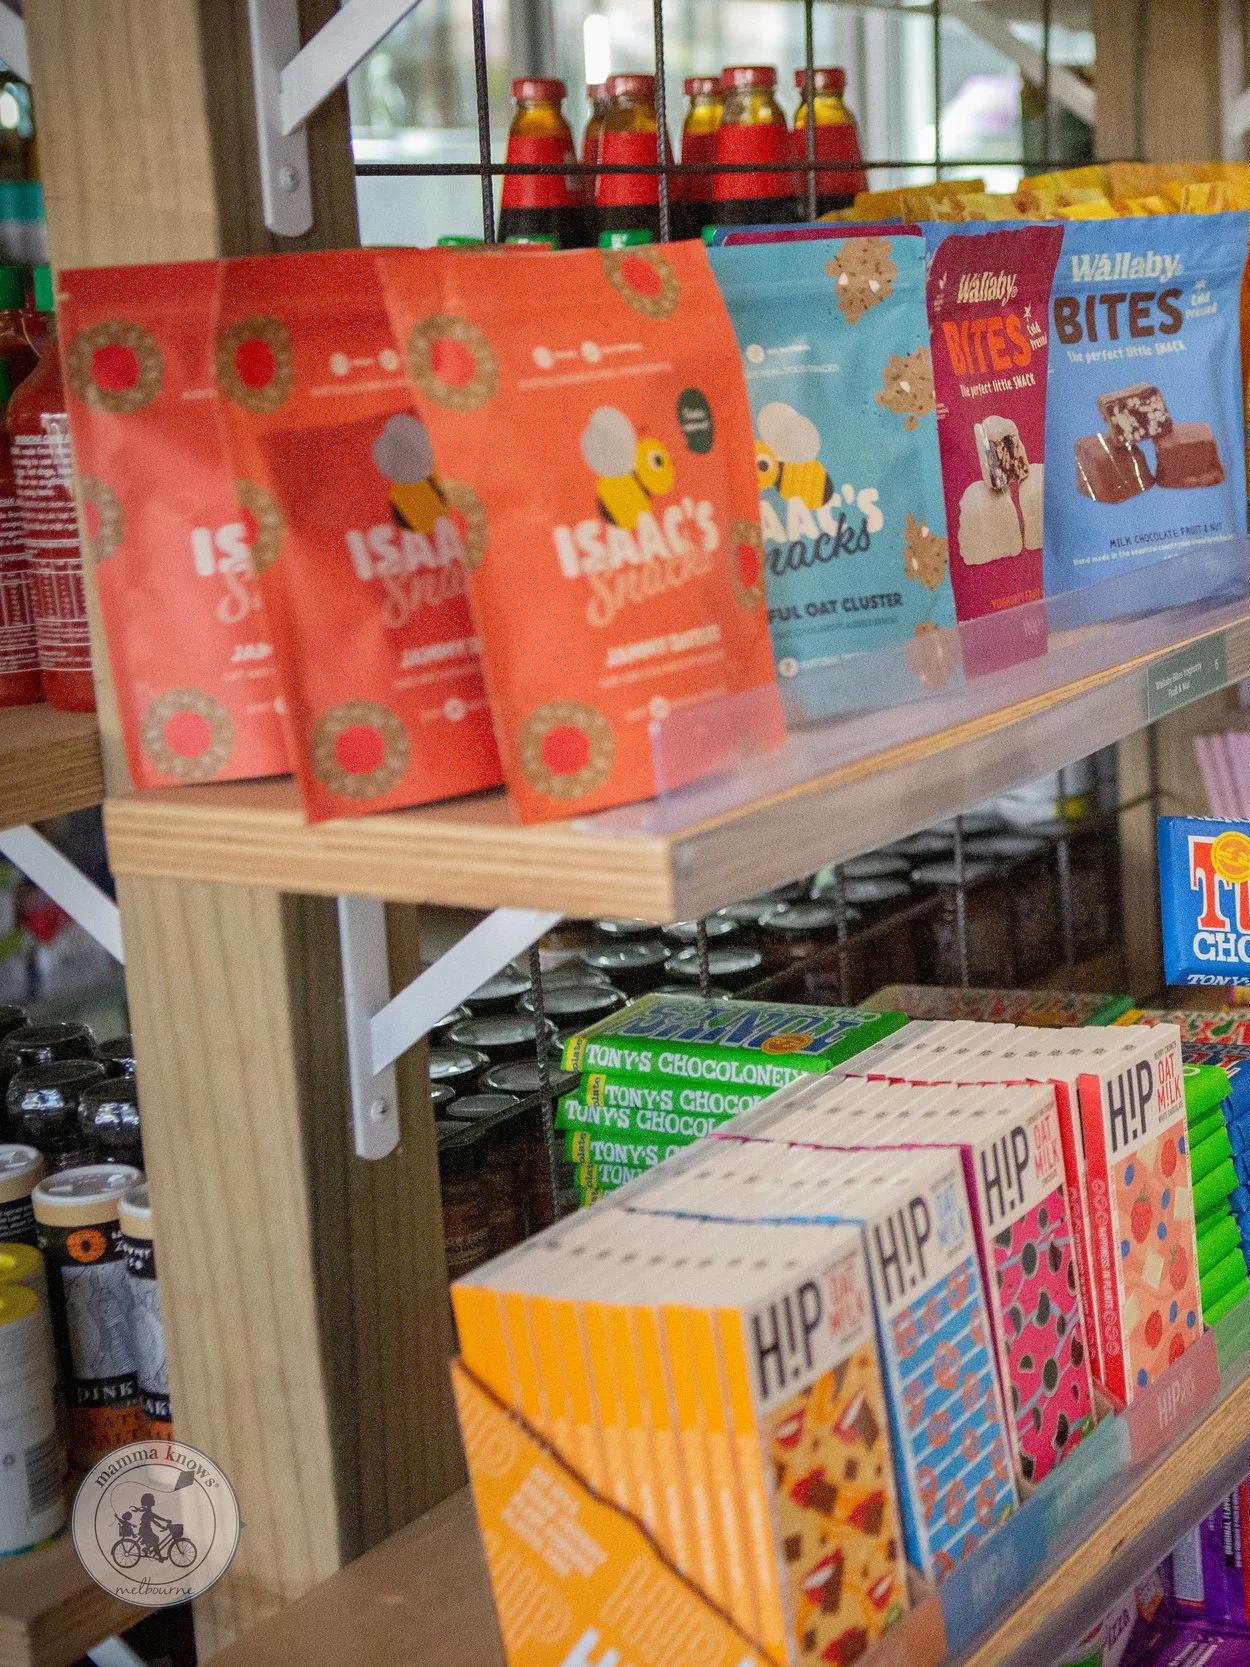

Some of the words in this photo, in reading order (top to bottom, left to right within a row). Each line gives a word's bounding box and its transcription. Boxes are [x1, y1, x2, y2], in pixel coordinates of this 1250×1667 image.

[1053, 288, 1184, 345] BITES
[941, 314, 1032, 377] BITES
[1013, 372, 1037, 391] SNACK
[760, 483, 884, 543] AAC'S
[345, 516, 463, 580] ISAA
[554, 497, 719, 579] ISAAC'S
[1109, 536, 1132, 549] MILK
[1134, 529, 1178, 544] CHOCOLATE
[768, 604, 803, 625] FUL
[804, 599, 840, 617] OAT
[586, 1044, 652, 1073] TONY'S
[1158, 1052, 1174, 1085] OAT
[604, 1085, 673, 1113] TONY'S
[680, 1089, 768, 1115] CHOCO
[565, 1100, 631, 1129] TONY'S
[636, 1109, 717, 1138] CHOCOL
[590, 1141, 659, 1166] TONY'S
